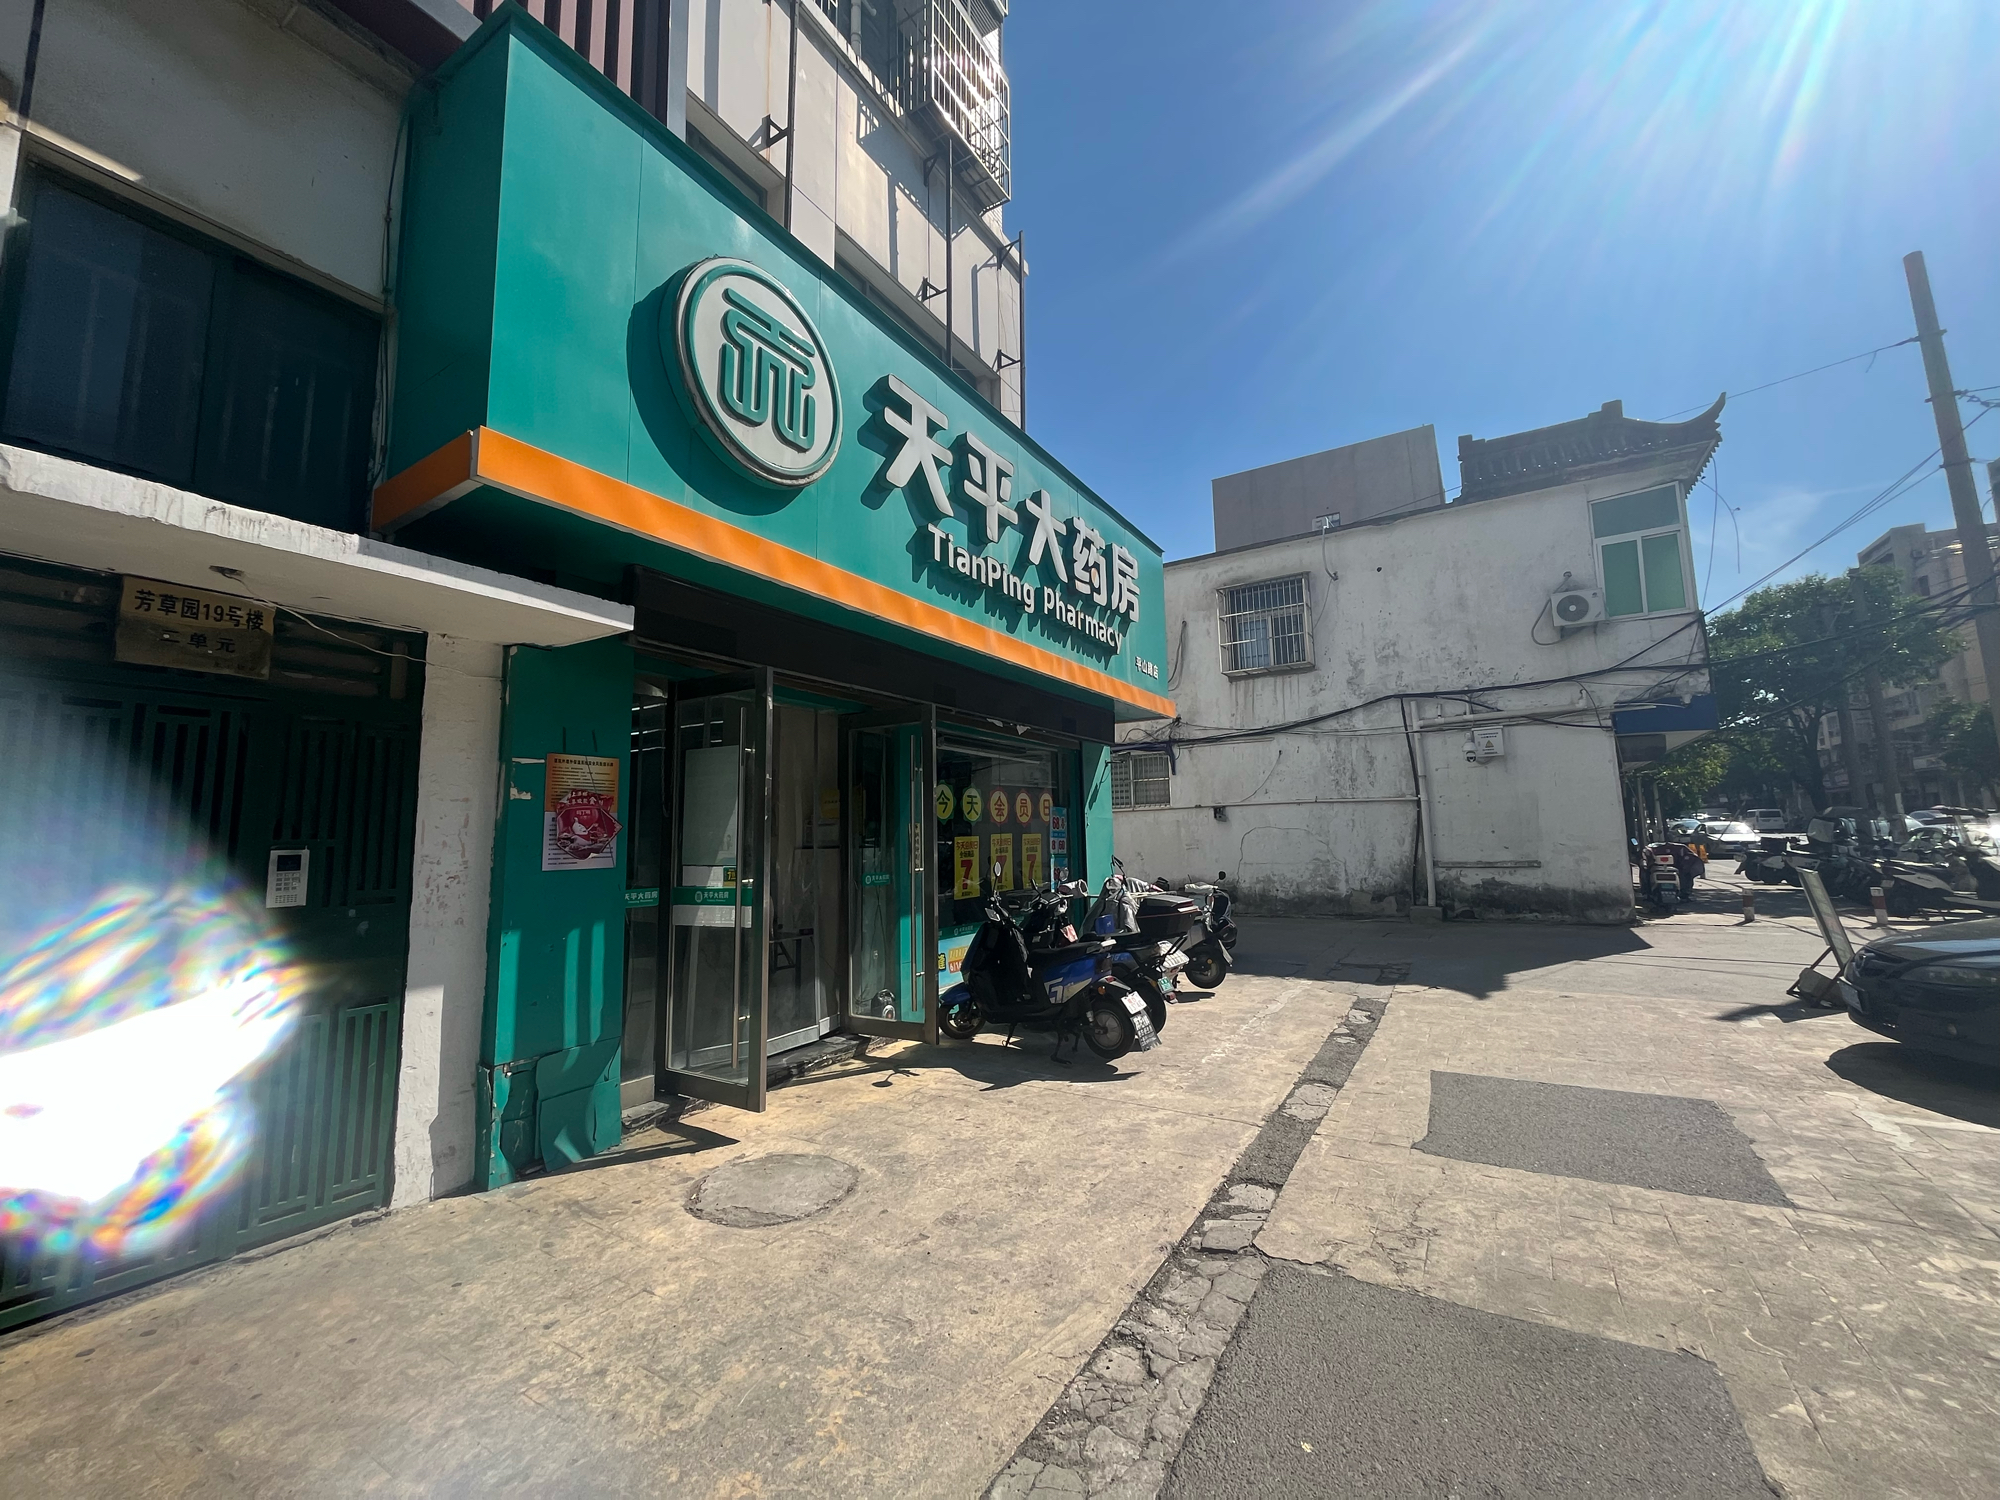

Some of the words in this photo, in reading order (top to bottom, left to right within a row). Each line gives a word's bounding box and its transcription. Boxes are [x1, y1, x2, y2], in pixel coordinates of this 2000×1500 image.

[884, 374, 1139, 622] 天平大药房
[135, 589, 264, 631] 芳草园19号楼
[928, 523, 1034, 614] TianPing
[1043, 585, 1122, 655] Pharmacy
[160, 630, 236, 653] 二单元
[937, 790, 1050, 818] 今天会员日
